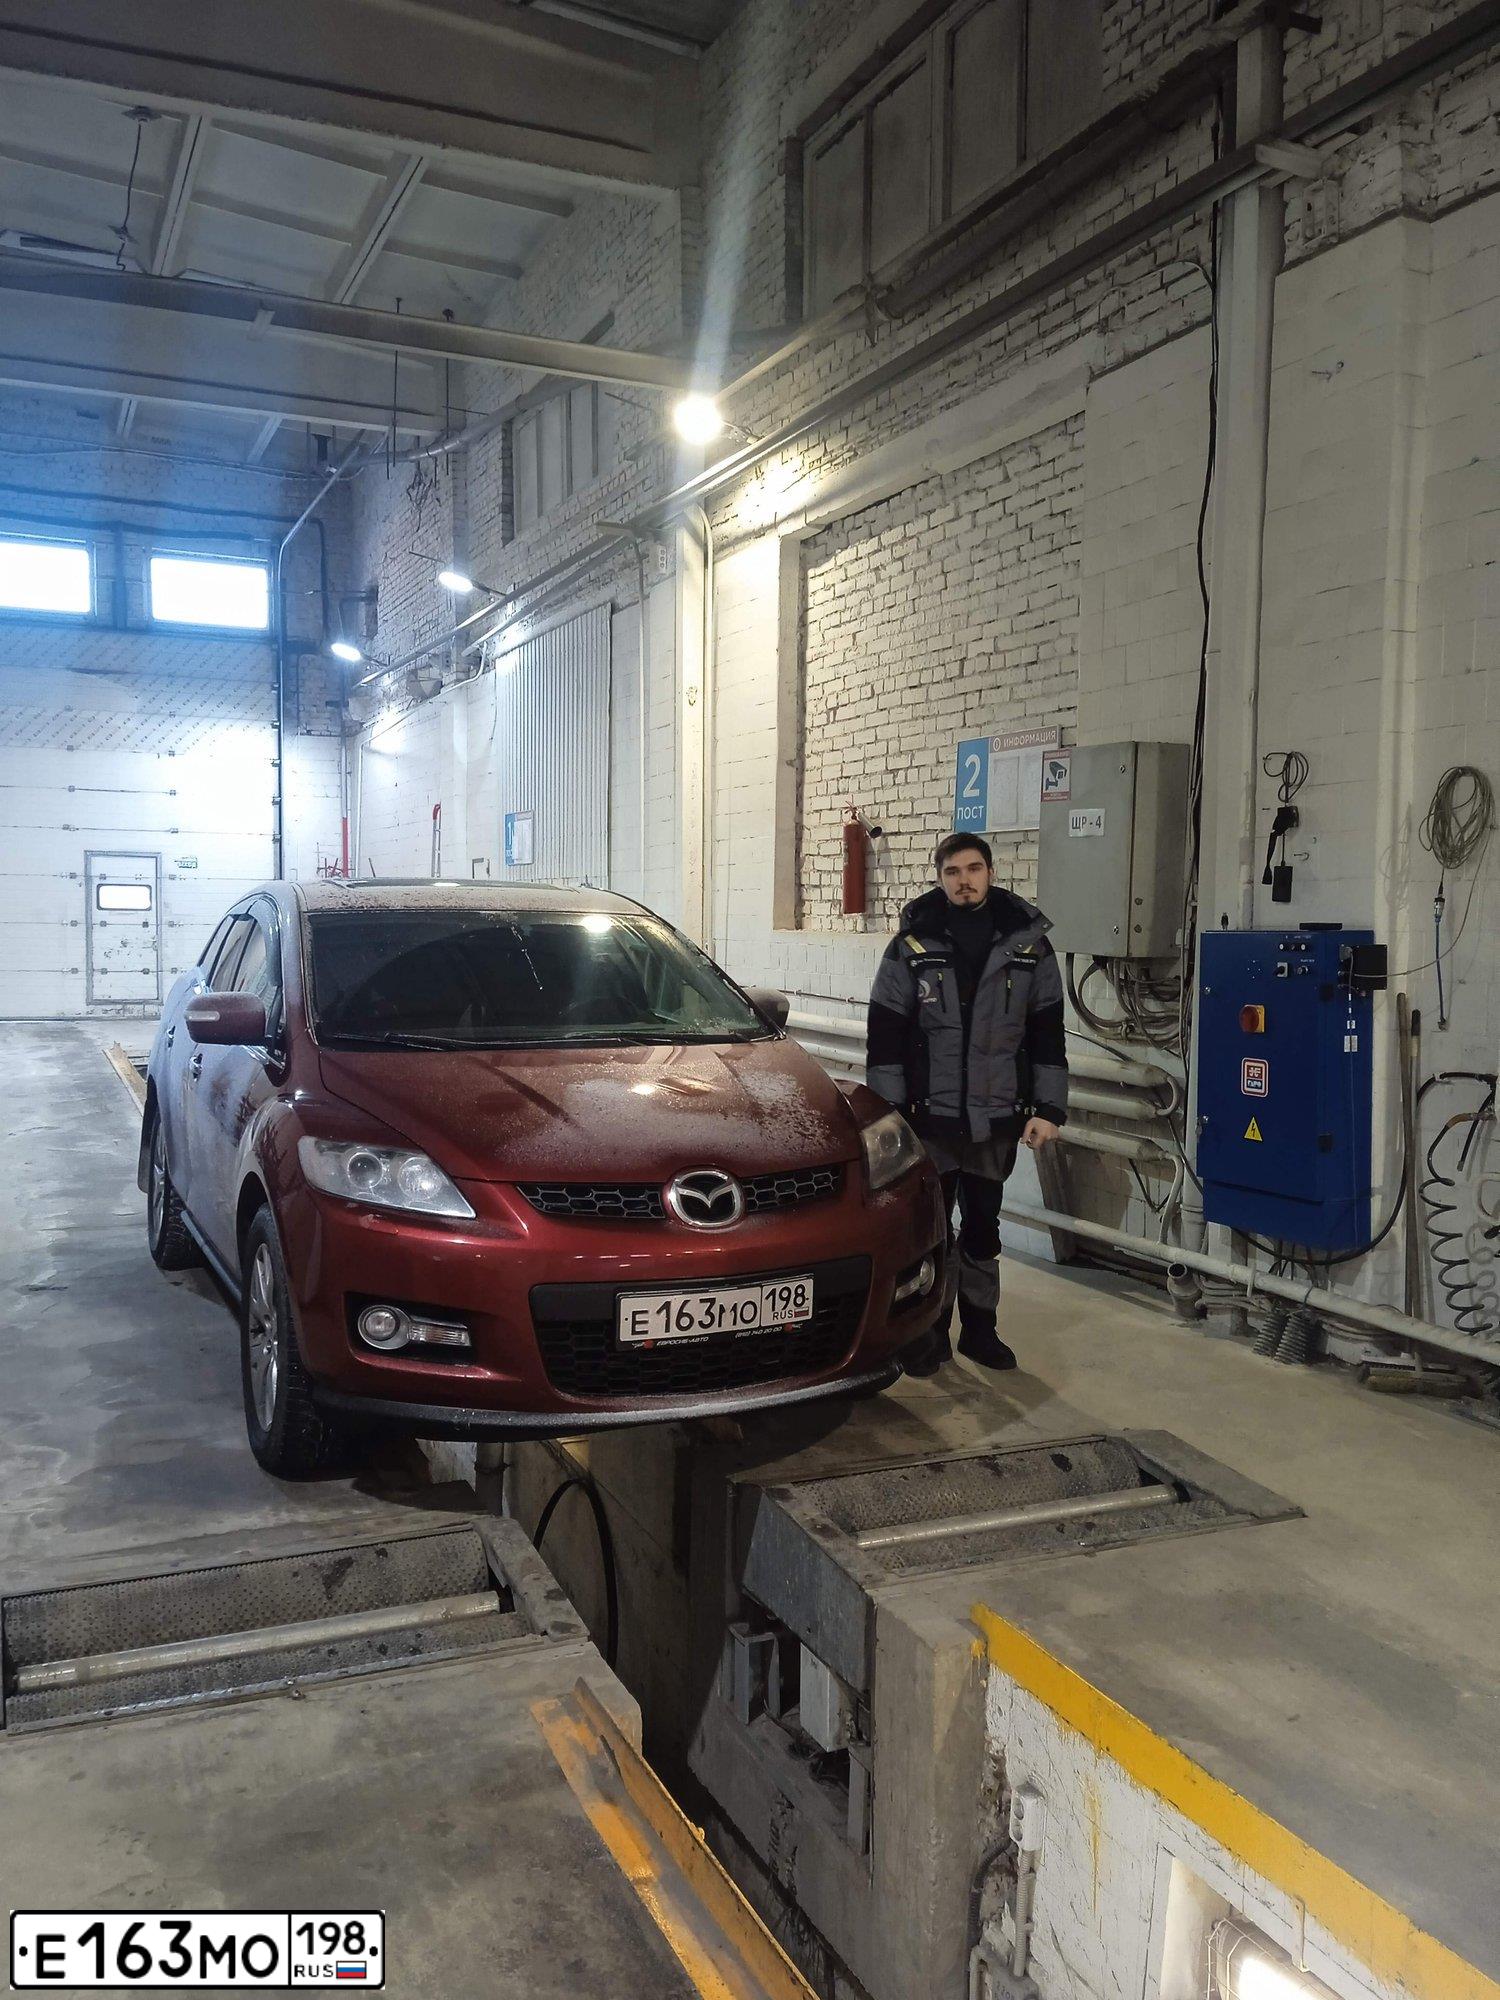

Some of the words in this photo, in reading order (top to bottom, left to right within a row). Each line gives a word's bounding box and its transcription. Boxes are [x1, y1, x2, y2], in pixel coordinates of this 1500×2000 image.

[1003, 731, 1056, 748] ИНФОРМАЦИЯ
[963, 753, 981, 798] 2
[957, 805, 985, 820] ПОСТ
[764, 1284, 807, 1311] 198
[772, 1309, 794, 1321] RUS
